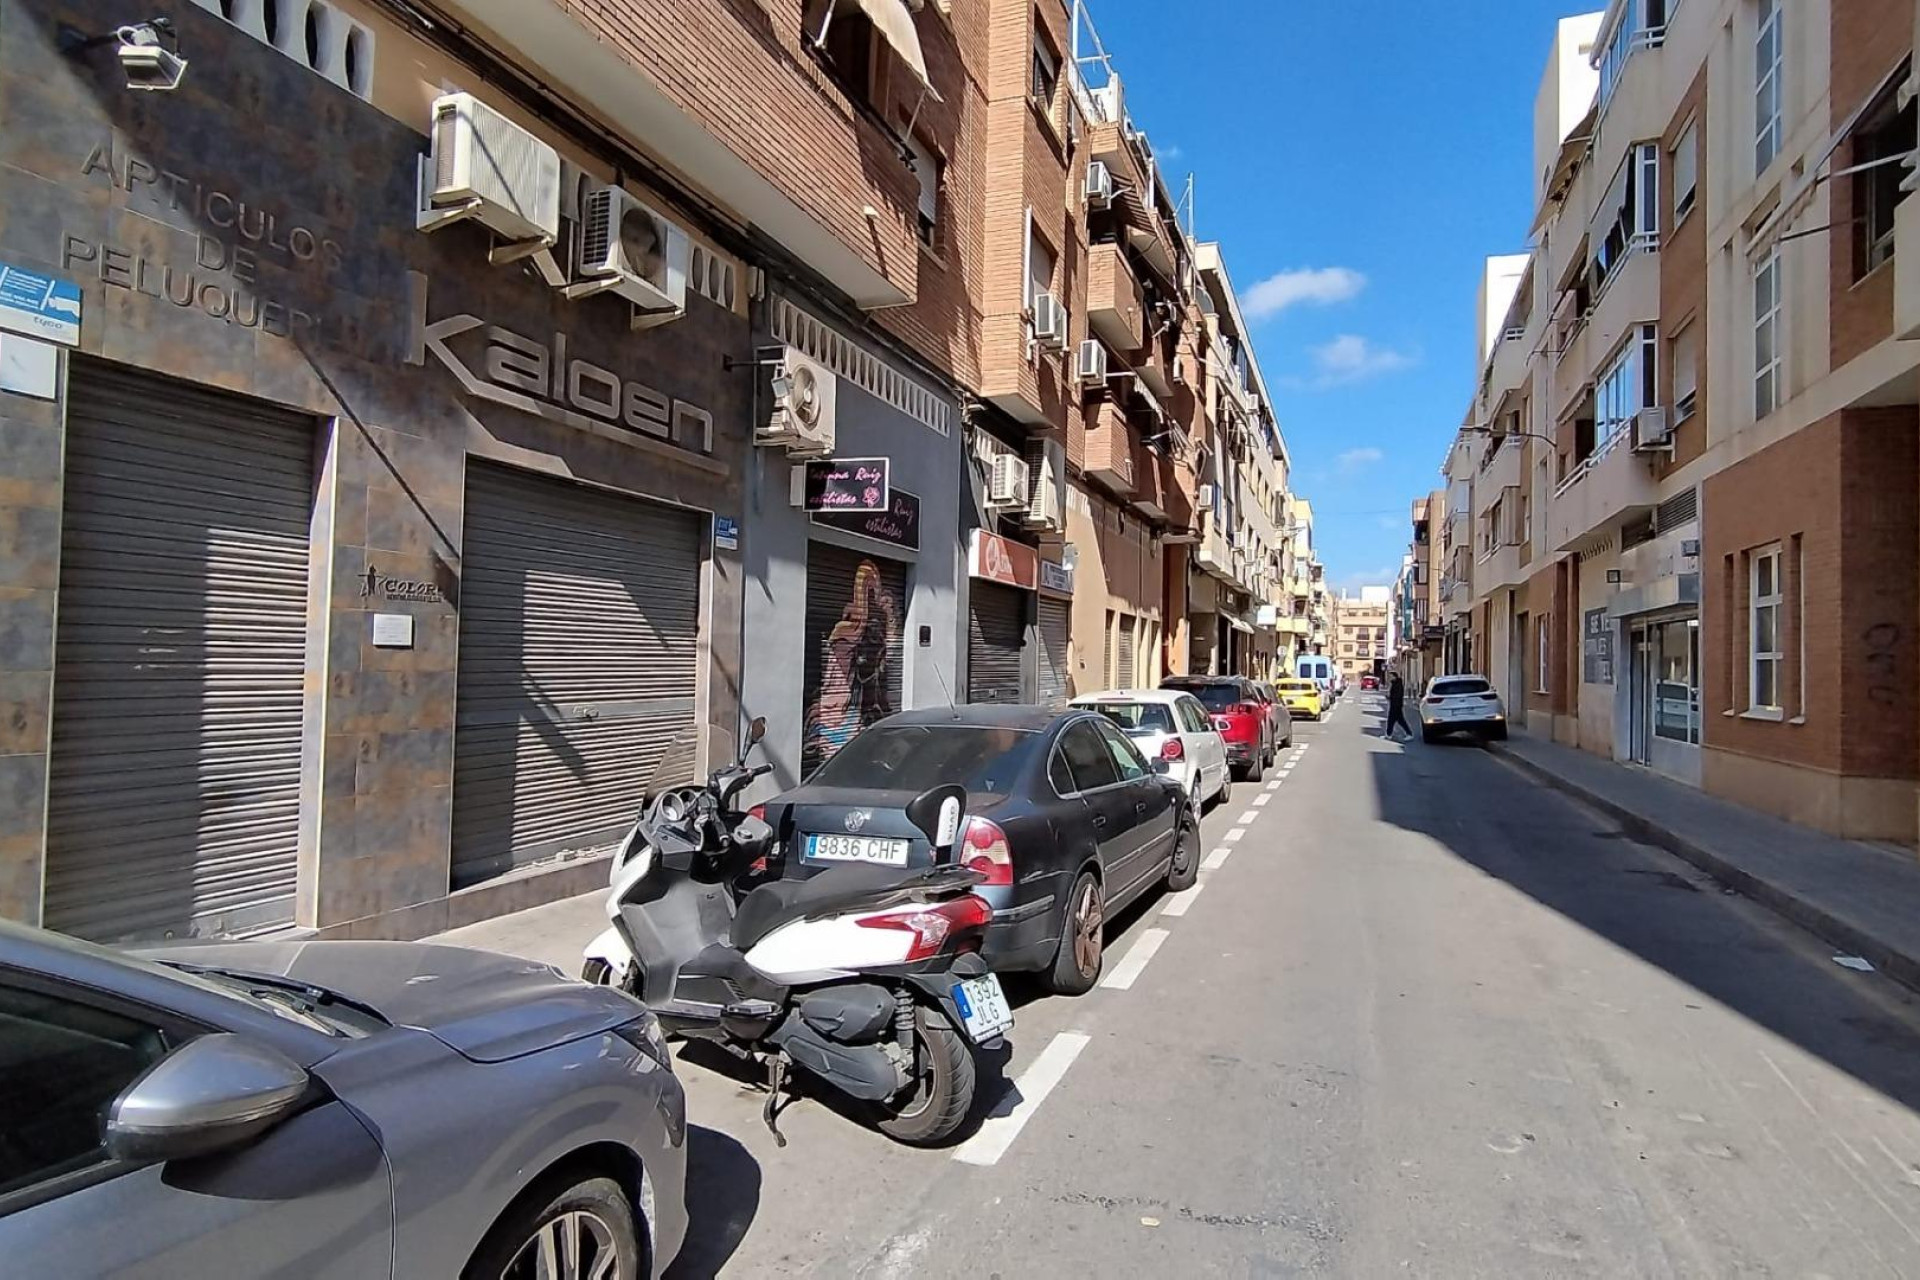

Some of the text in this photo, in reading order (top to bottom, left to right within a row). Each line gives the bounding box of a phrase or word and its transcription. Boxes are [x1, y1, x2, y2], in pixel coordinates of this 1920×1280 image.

[80, 139, 343, 272] ARTICULOS
[195, 231, 257, 284] DE
[402, 268, 715, 454] Kaloen
[818, 835, 903, 861] 9836 CHF
[964, 977, 1000, 1005] 1392
[976, 1001, 1000, 1027] JLG
